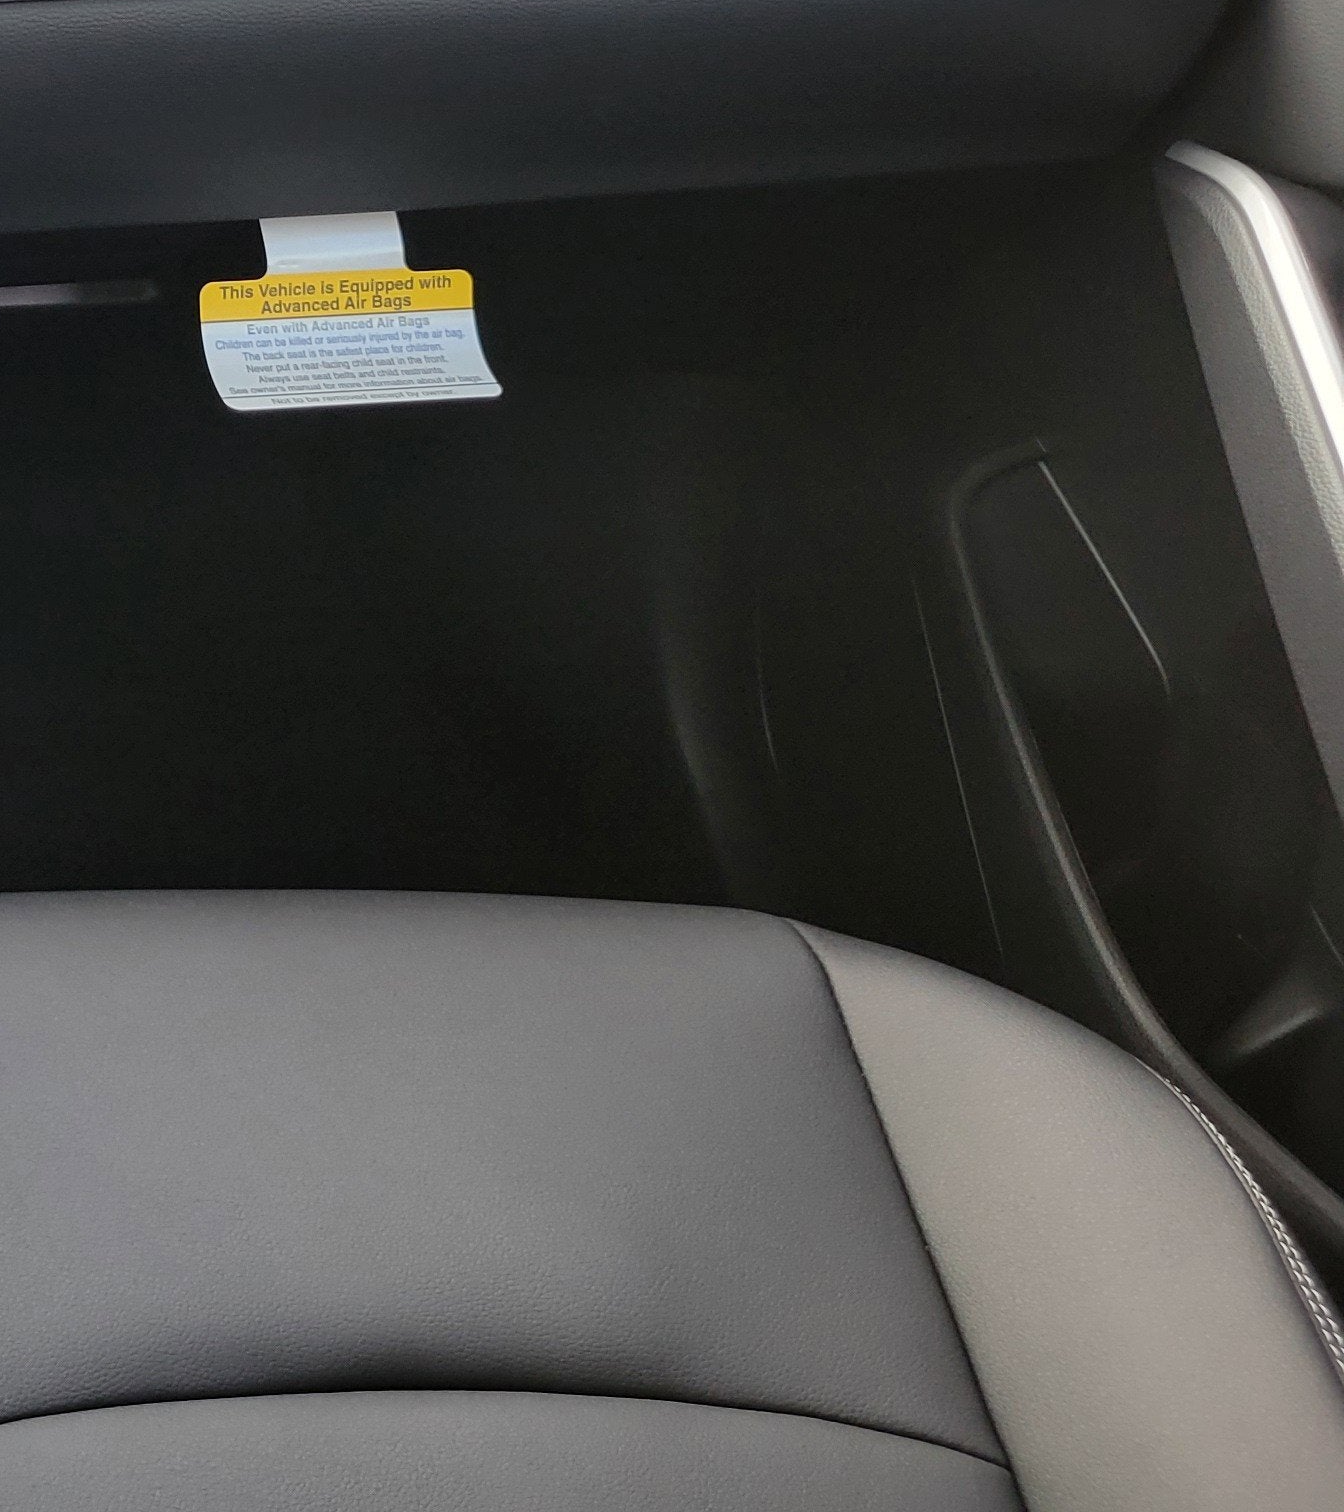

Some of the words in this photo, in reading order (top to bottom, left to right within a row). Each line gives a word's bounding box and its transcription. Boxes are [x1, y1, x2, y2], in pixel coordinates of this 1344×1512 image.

[220, 286, 253, 300] This
[258, 282, 316, 297] Vehicle
[340, 277, 414, 295] Equipped
[419, 276, 452, 288] with
[261, 297, 339, 314] Advanced
[344, 297, 367, 310] Air
[372, 295, 411, 310] Bags
[247, 324, 278, 335] Even
[282, 321, 308, 333] with
[312, 319, 374, 331] Advanced
[377, 317, 394, 328] Air
[398, 316, 430, 328] Bags
[216, 340, 253, 350] Children
[256, 339, 272, 347] can
[275, 338, 287, 347] be
[289, 336, 311, 345] killed
[369, 331, 400, 343] injured
[402, 331, 412, 341] by
[415, 330, 429, 338] the
[432, 329, 442, 337] air
[445, 328, 465, 339] bag.
[242, 352, 260, 361] The
[263, 351, 284, 360] back
[287, 349, 306, 359] seat
[309, 349, 317, 358] is
[319, 348, 333, 357] the
[365, 346, 389, 356] place
[392, 345, 404, 353] for
[406, 343, 444, 352] children.
[246, 364, 273, 373] Never
[352, 357, 374, 367] child
[375, 357, 395, 365] seat
[397, 356, 405, 365] in
[407, 356, 422, 364] the
[258, 374, 291, 384] Always
[312, 372, 332, 380] seat
[359, 369, 375, 377] and
[377, 368, 399, 376] child
